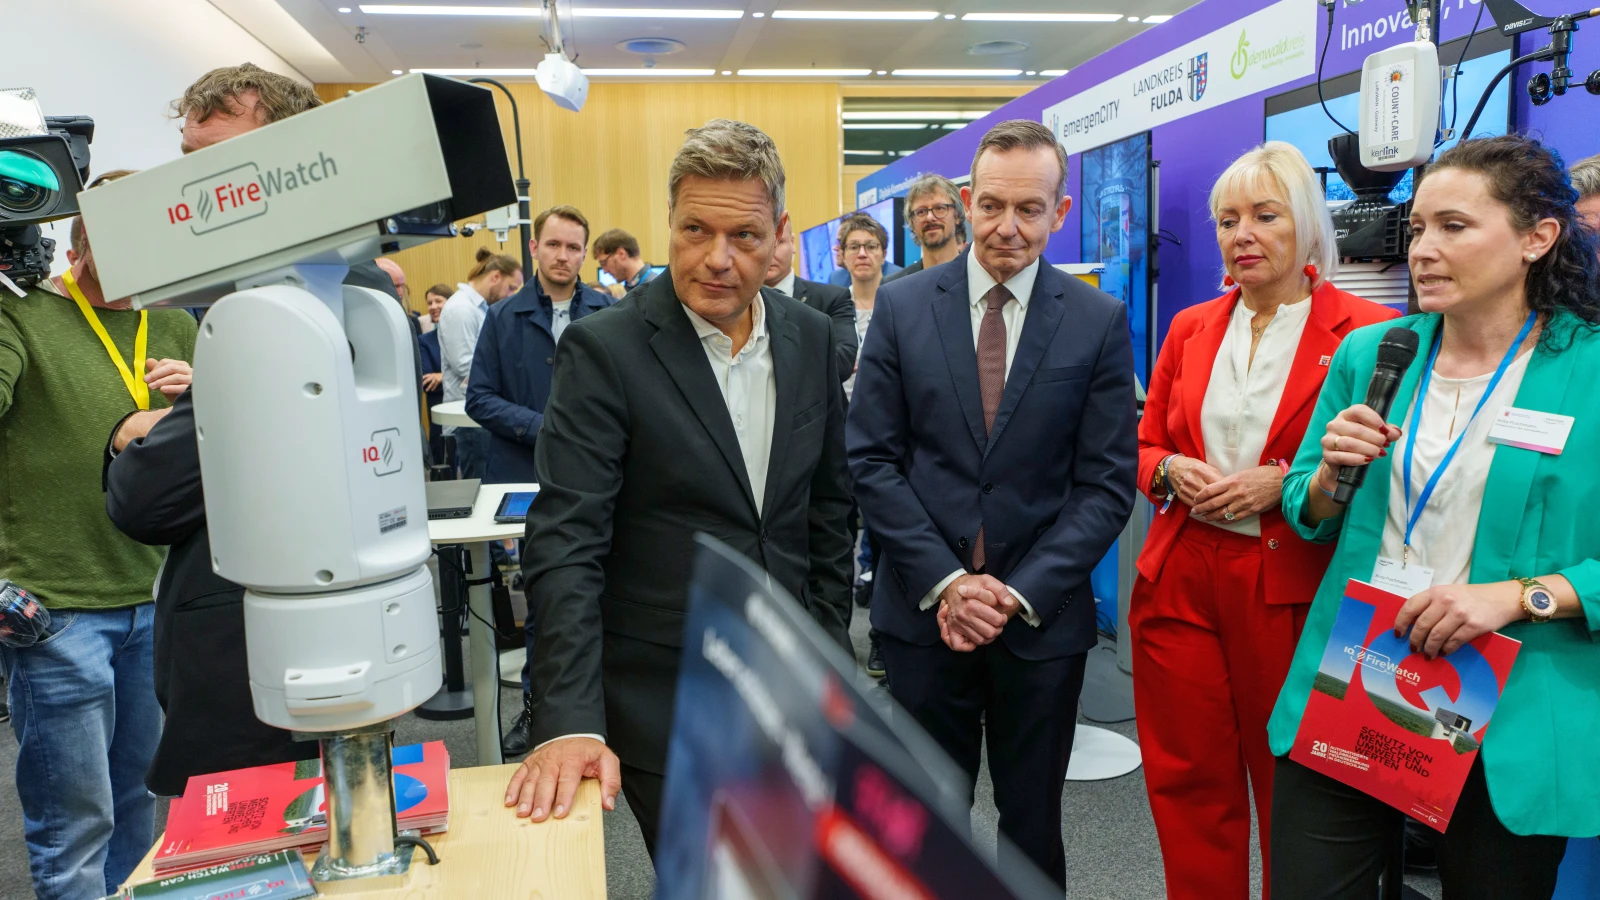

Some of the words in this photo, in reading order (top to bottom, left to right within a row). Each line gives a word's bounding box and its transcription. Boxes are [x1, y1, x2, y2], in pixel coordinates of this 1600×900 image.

[1133, 62, 1183, 97] LANDKREIS
[1151, 87, 1183, 112] FULDA
[1391, 86, 1400, 142] COUNT+CARE
[1063, 99, 1120, 137] emergenCITY
[1371, 146, 1399, 158] kerlink
[168, 203, 193, 224] IQ
[215, 152, 338, 213] FireWatch
[363, 446, 380, 463] IQ
[1343, 646, 1355, 656] IQ
[1366, 653, 1421, 683] FireWatch
[1312, 740, 1328, 753] 20
[1354, 745, 1399, 771] WERTEN
[1356, 740, 1402, 764] UMWELT
[1405, 761, 1430, 778] UND
[1361, 726, 1406, 750] SCHUTZ
[1408, 746, 1433, 764] VON
[214, 782, 228, 793] 20
[160, 875, 185, 887] CAN
